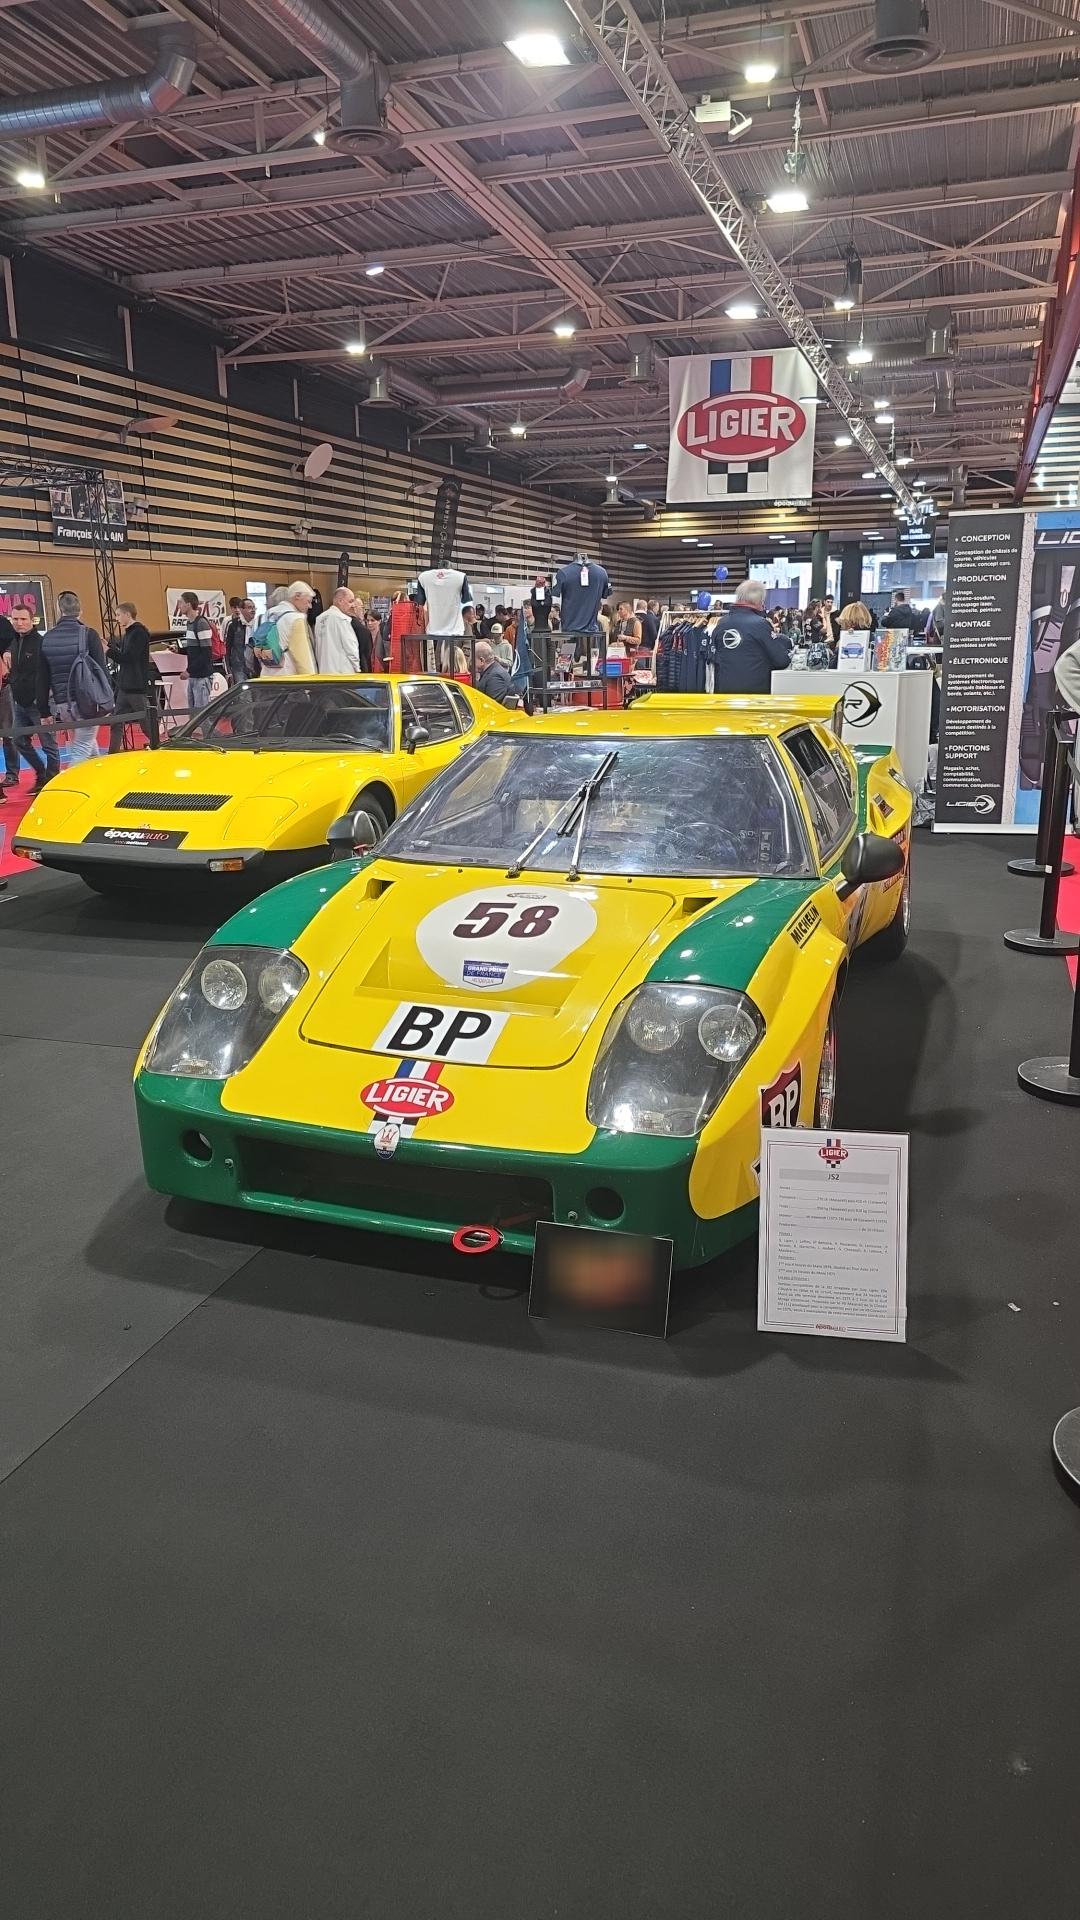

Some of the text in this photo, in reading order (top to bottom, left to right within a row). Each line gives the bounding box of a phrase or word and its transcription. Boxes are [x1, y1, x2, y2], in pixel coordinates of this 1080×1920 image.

[686, 406, 796, 447] LIGIER
[57, 526, 92, 540] François
[961, 534, 1010, 542] CONCEPTION
[957, 574, 1007, 582] PRODUCTION
[104, 829, 169, 840] époquauto
[453, 902, 560, 938] 58
[790, 904, 820, 944] MICHELIN
[386, 1005, 492, 1057] BP
[365, 1083, 449, 1112] LIGIER
[768, 1080, 799, 1127] BP
[820, 1149, 847, 1157] LIGIER
